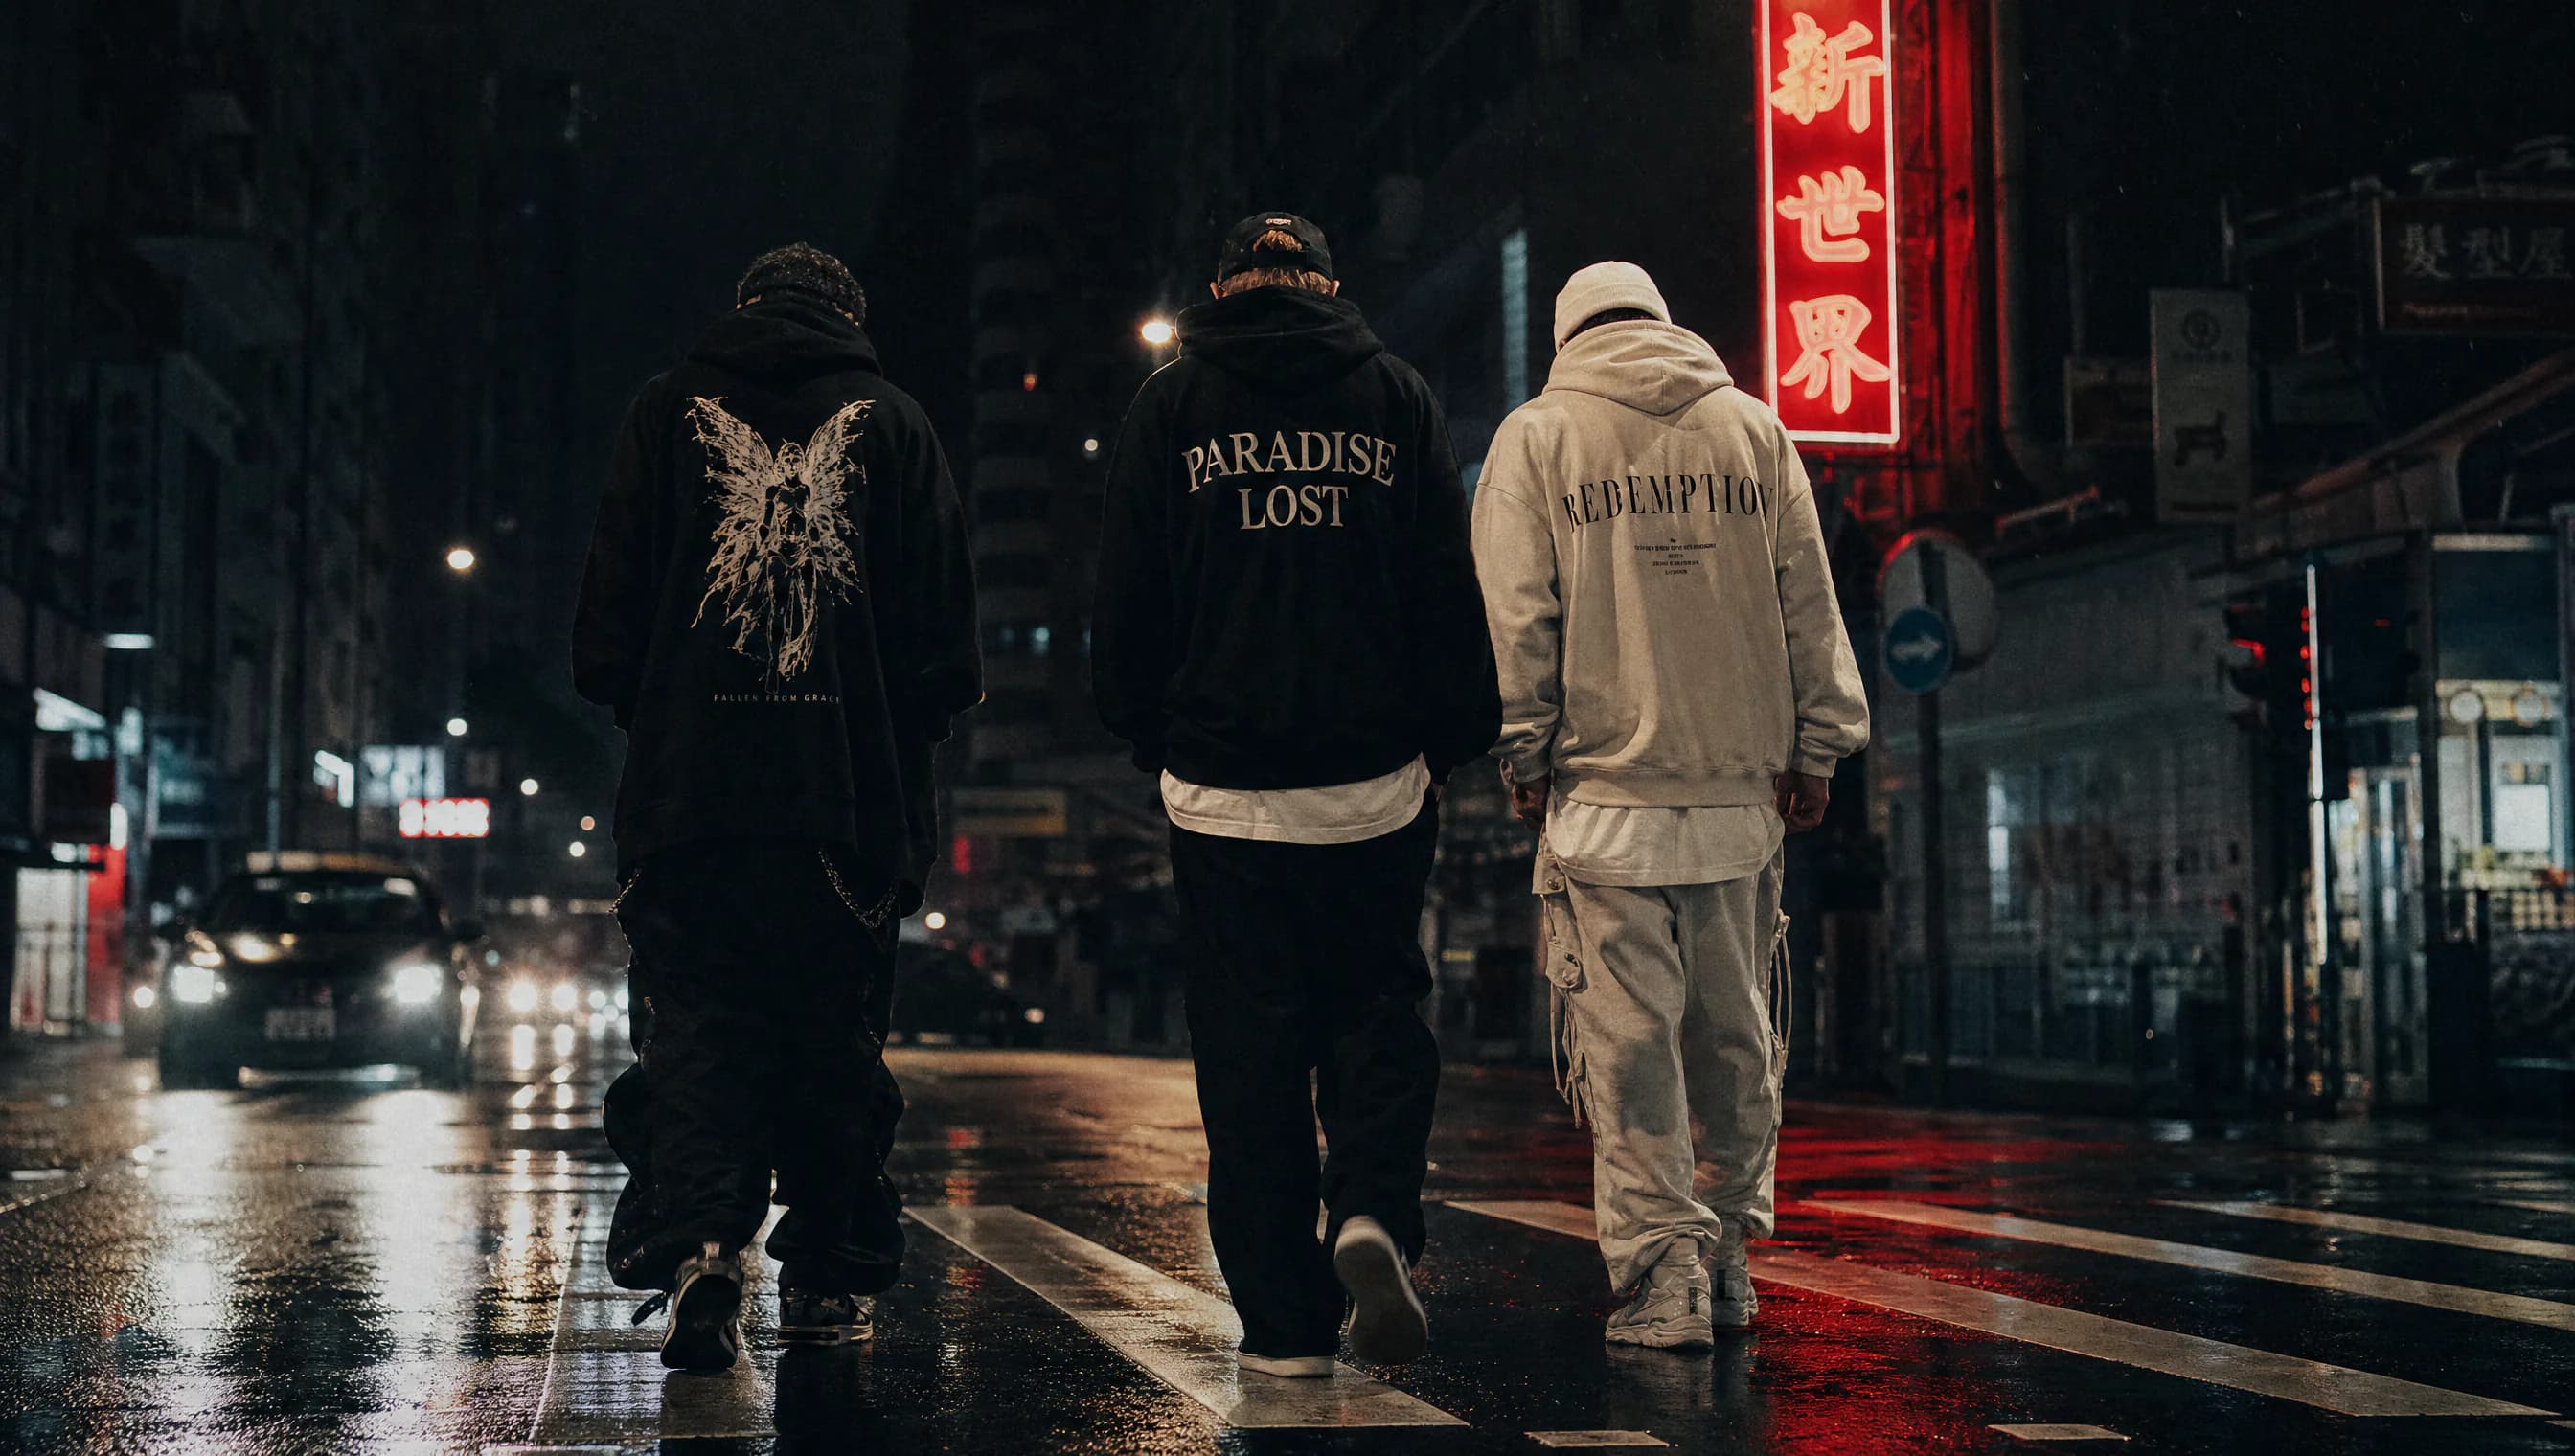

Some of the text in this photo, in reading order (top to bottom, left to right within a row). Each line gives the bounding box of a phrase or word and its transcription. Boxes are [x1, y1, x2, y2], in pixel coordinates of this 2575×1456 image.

[1770, 12, 1891, 414] 新世界
[1181, 430, 1397, 493] PARADISE
[1238, 484, 1349, 530] LOST
[713, 694, 759, 703] FALLEN
[766, 694, 797, 703] FROM
